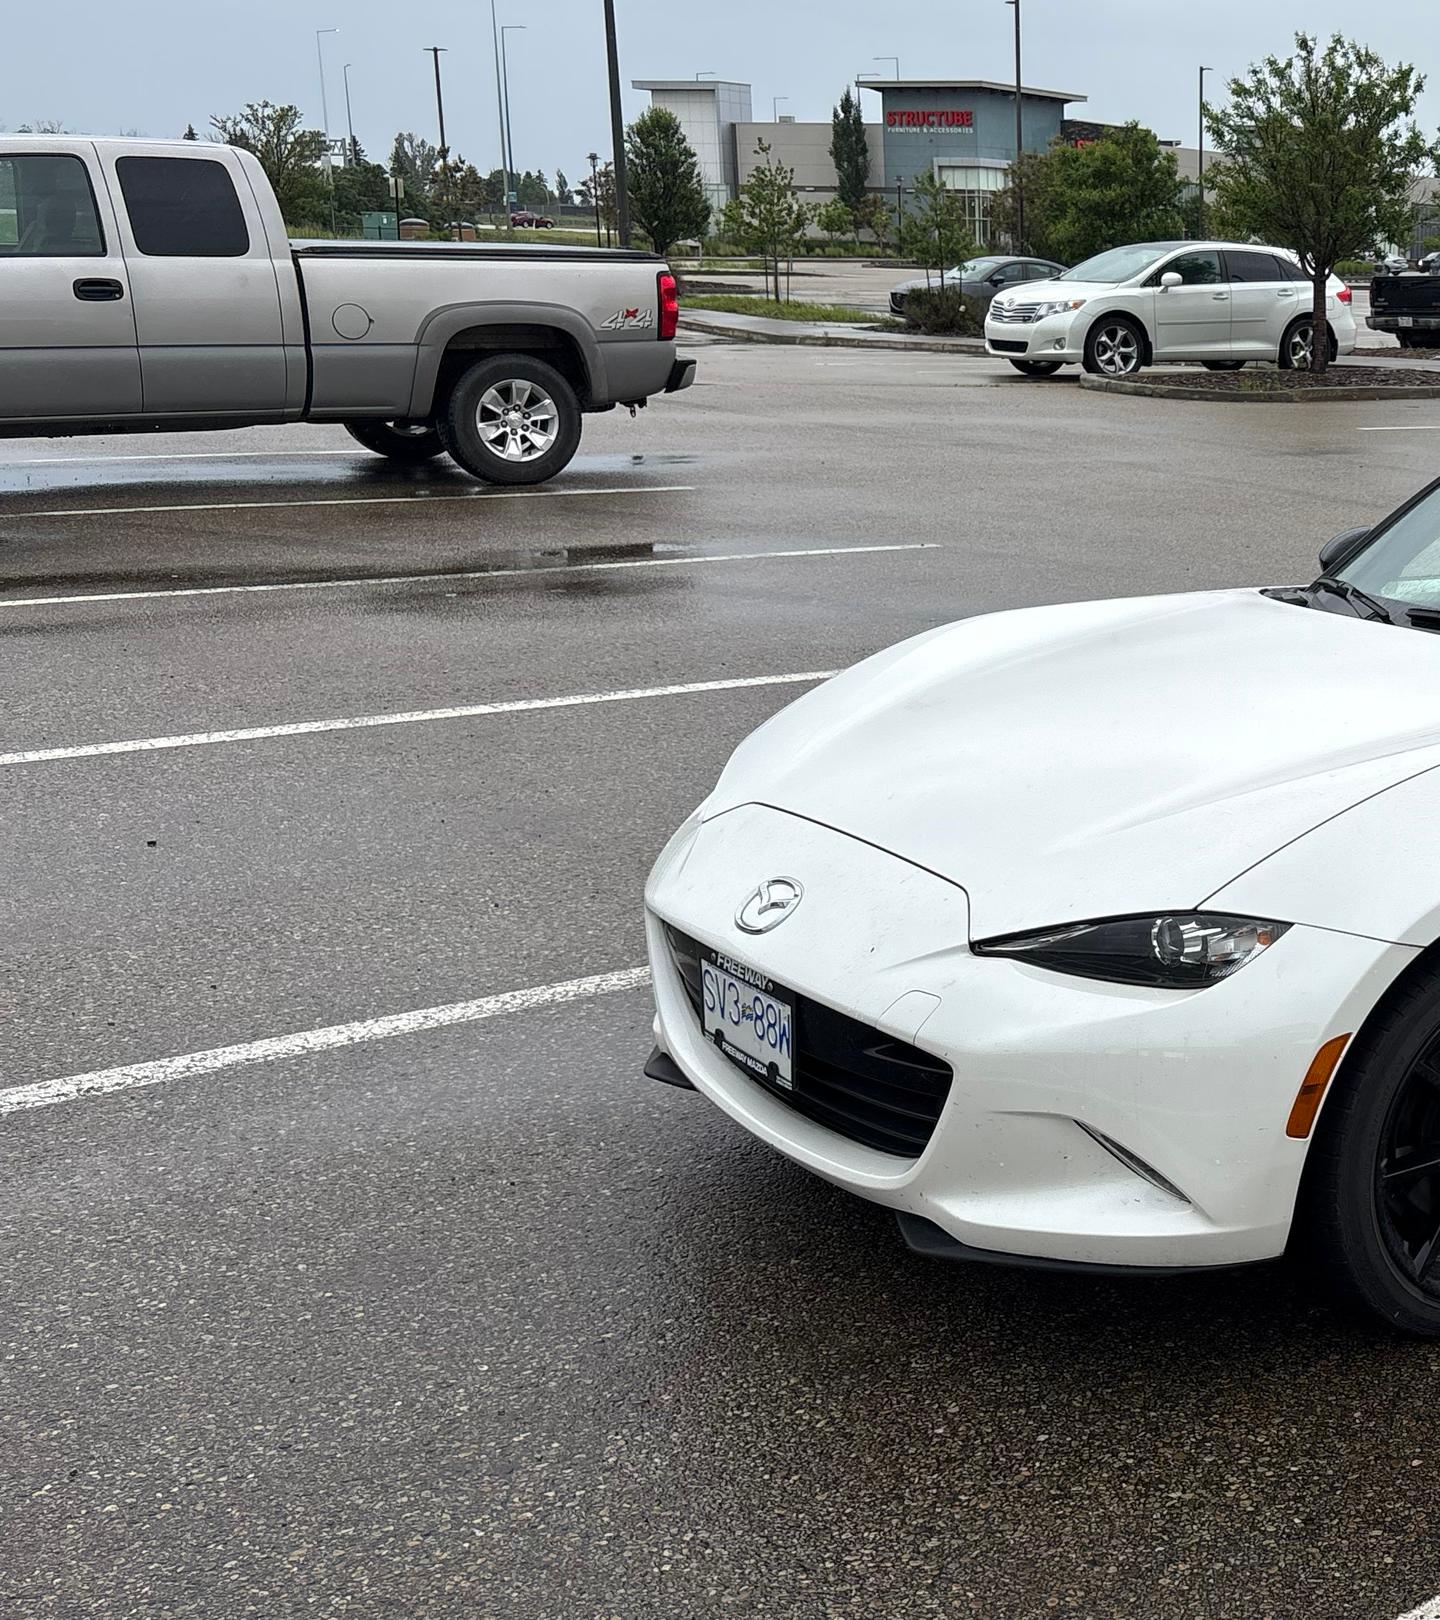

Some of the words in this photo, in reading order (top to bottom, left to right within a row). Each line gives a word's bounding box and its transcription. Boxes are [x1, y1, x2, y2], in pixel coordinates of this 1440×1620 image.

[886, 110, 974, 127] STRUCTUBE
[716, 952, 770, 990] FREEWAY
[721, 1041, 747, 1064] FREEWAY
[747, 1056, 769, 1077] MAZDA
